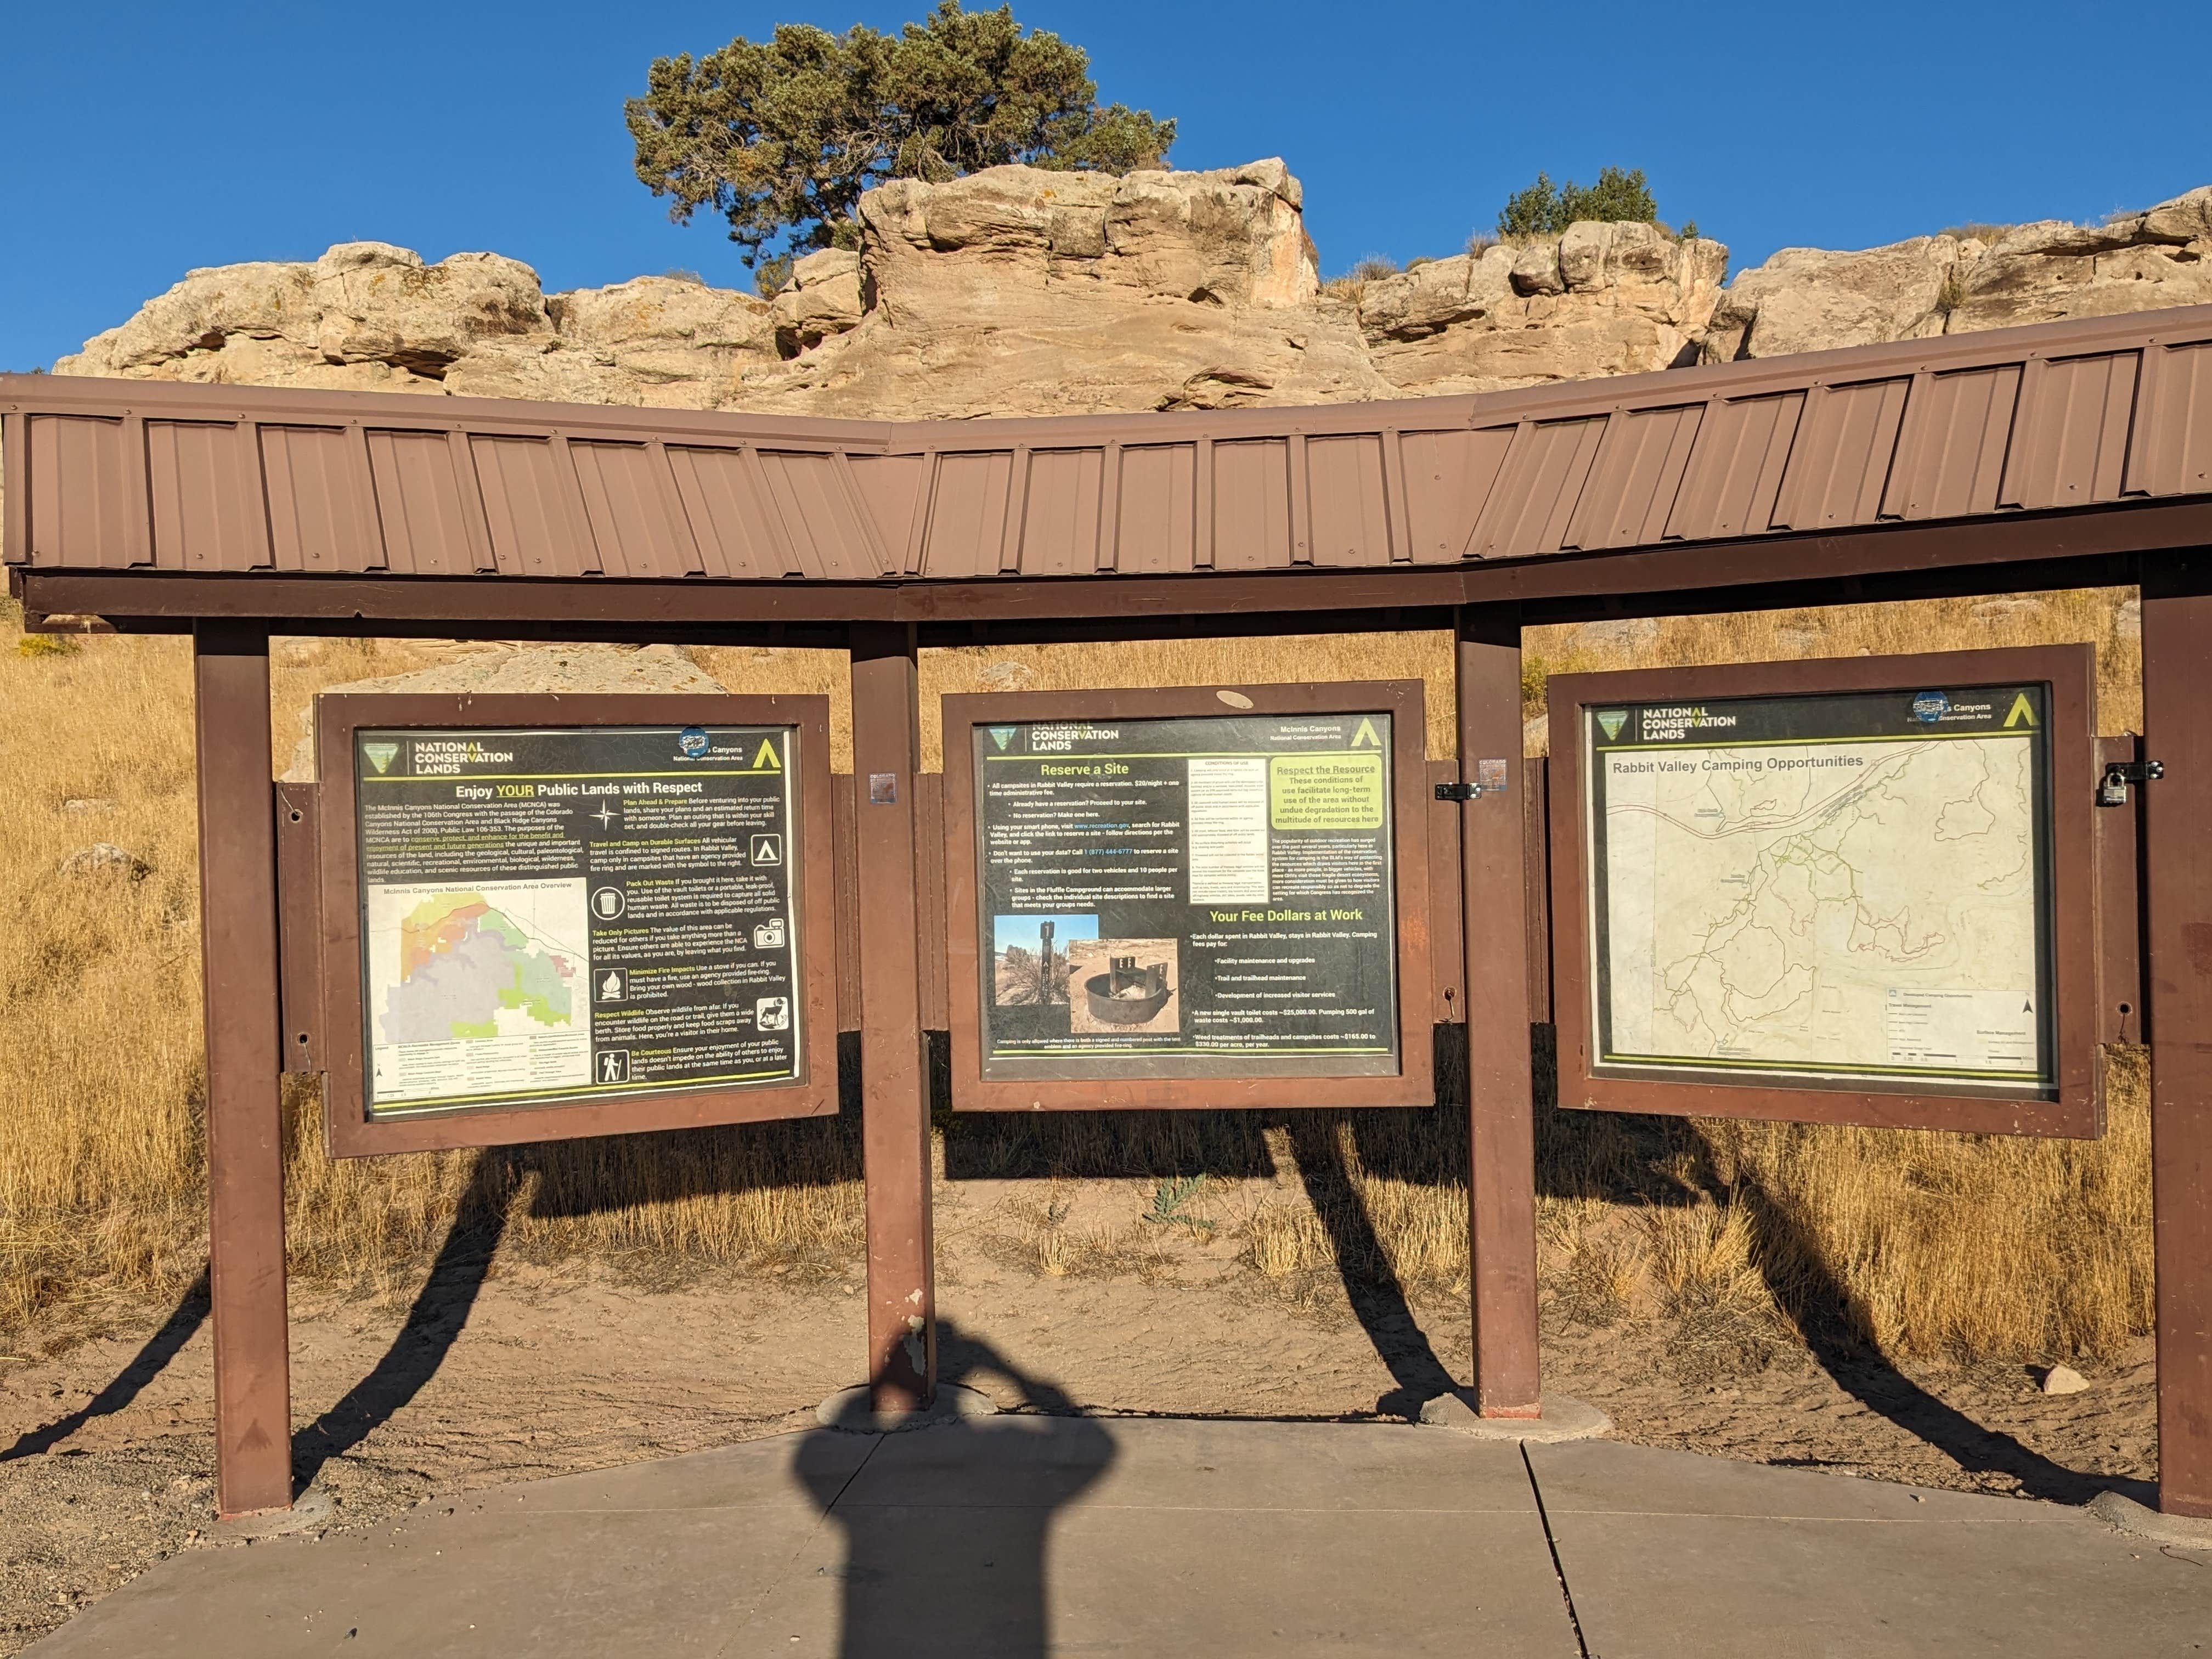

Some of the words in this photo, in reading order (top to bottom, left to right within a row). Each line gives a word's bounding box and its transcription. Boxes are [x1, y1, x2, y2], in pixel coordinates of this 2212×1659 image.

[1644, 707, 1709, 719] NATIONAL
[1954, 704, 1991, 712] Canyons
[1643, 716, 1735, 729] CONSERVATION
[1310, 725, 1340, 733] Canyons
[1032, 730, 1118, 740] CONSERVATION
[1644, 729, 1684, 740] LANDS
[415, 742, 484, 752] NATIONAL
[1032, 741, 1071, 750] LANDS
[415, 752, 512, 763] CONSERVATION
[416, 764, 460, 774] LANDS
[1613, 759, 1654, 774] Rabbit
[1658, 758, 1696, 775] Valley
[1702, 756, 1762, 774] Camping
[1767, 753, 1863, 772] Opportunities
[1041, 764, 1090, 775] Reserve
[1104, 764, 1128, 774] Site
[1277, 767, 1313, 776] Respect
[1333, 765, 1375, 774] Resource
[456, 786, 492, 800] Enjoy
[496, 785, 534, 797] YOUR
[538, 785, 578, 795] Public
[582, 783, 619, 795] Lands
[623, 783, 649, 794] with
[653, 782, 702, 796] Respect
[1333, 786, 1370, 795] long-term
[404, 803, 432, 811] Canyons
[1305, 805, 1349, 815] degradation
[1210, 910, 1238, 922] Your
[1242, 910, 1263, 921] Fee
[1268, 910, 1311, 921] Dollars
[1314, 909, 1326, 920] at
[1330, 909, 1362, 920] Work
[608, 929, 622, 937] Only
[672, 965, 695, 974] Impacts
[595, 1011, 619, 1019] Respect
